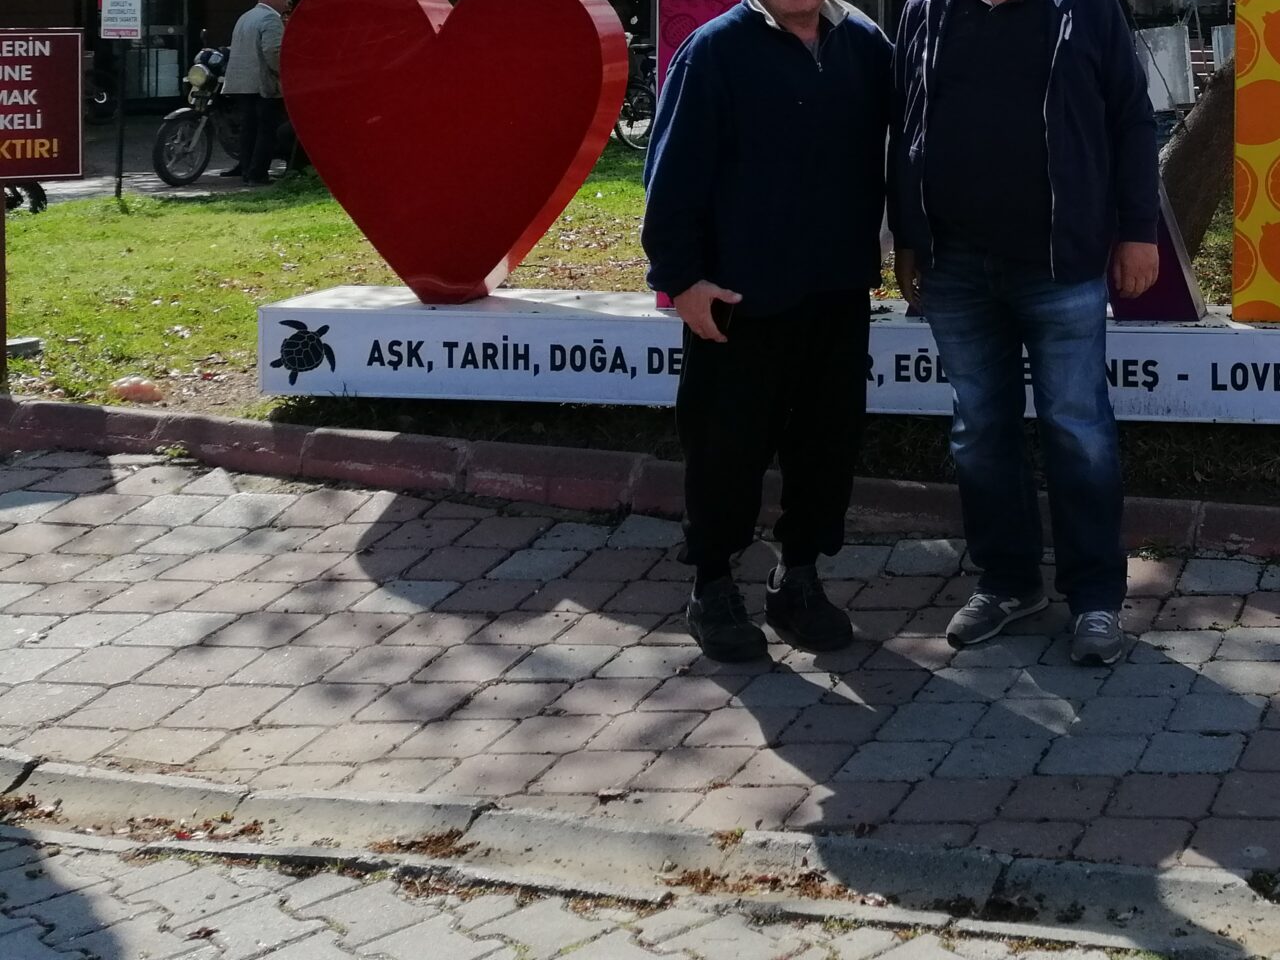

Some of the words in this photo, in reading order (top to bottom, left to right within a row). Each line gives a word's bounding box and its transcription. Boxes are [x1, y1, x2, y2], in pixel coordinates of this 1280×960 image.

[0, 36, 50, 57] ERİN
[0, 109, 42, 130] KELİ
[0, 138, 58, 159] KTIR!
[366, 339, 434, 374] AŞK,
[442, 334, 540, 377] TARİH,
[549, 338, 637, 380] DOĞA,
[1104, 358, 1160, 393] NEŞ
